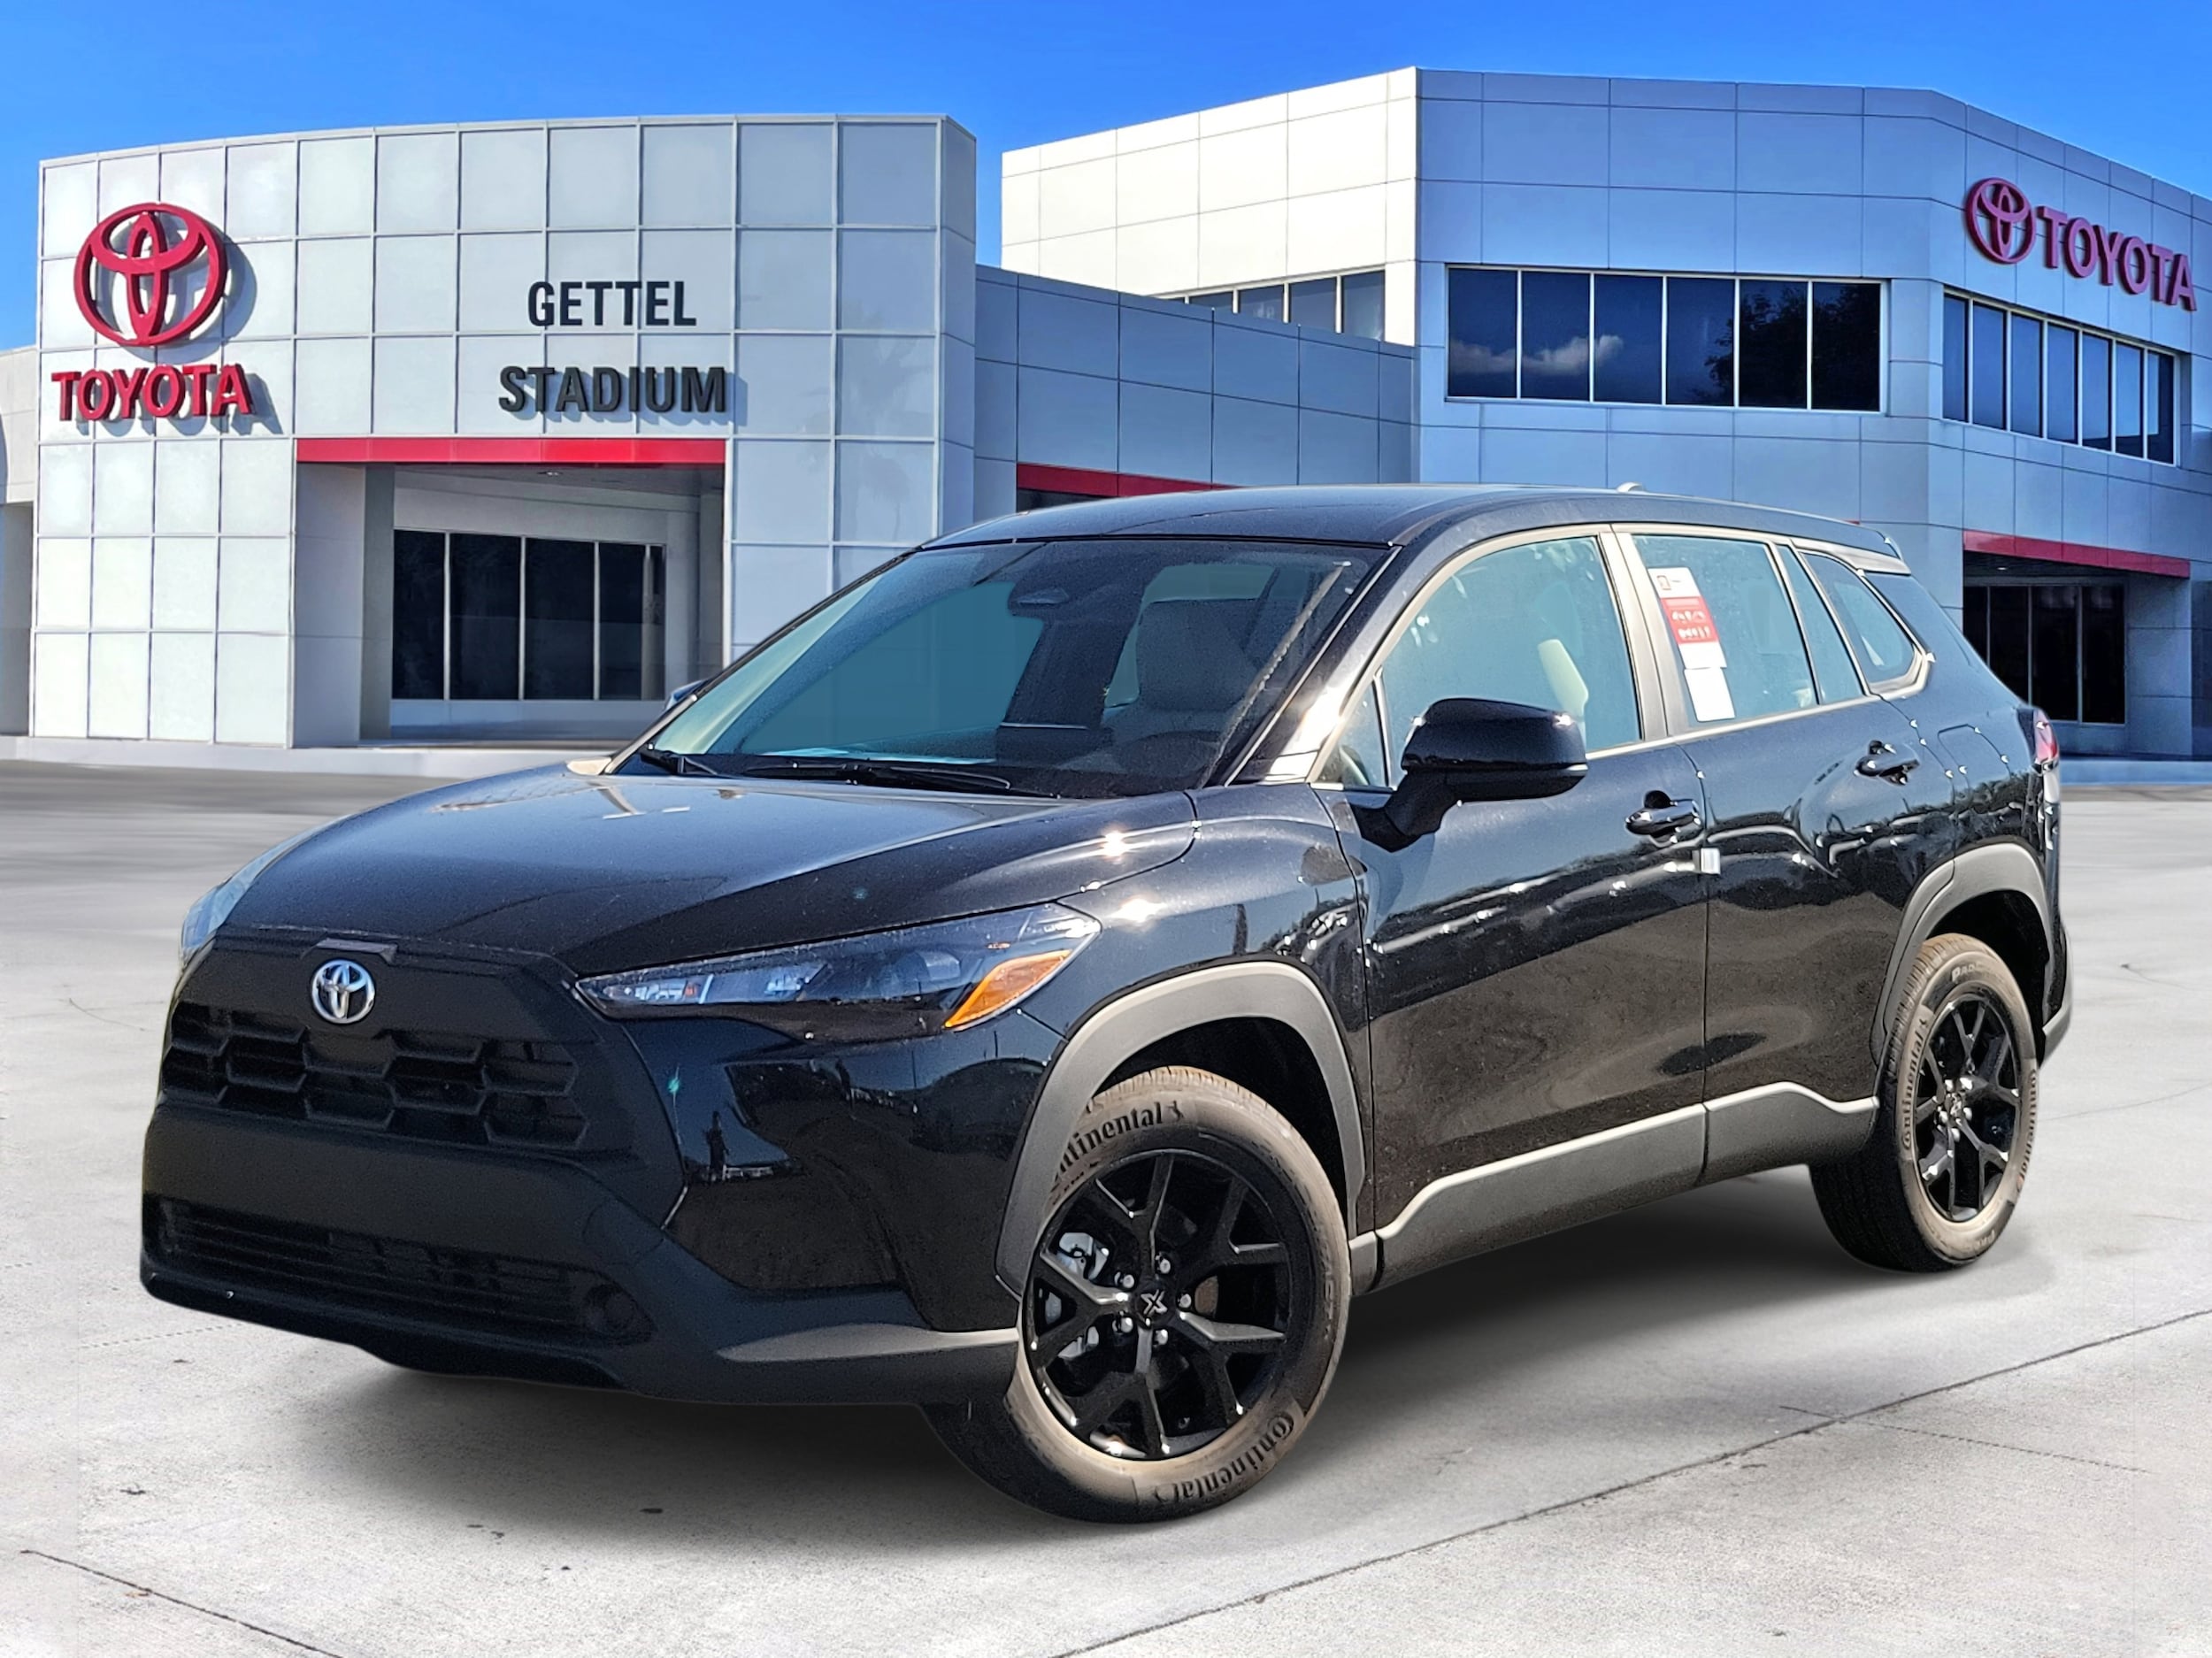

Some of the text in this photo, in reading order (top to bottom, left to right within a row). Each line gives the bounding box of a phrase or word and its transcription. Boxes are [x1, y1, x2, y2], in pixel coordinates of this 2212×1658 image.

[2037, 205, 2196, 311] TOYOTA
[528, 281, 696, 326] GETTEL
[51, 364, 253, 421] TOYOTA
[498, 366, 726, 413] STADIUM
